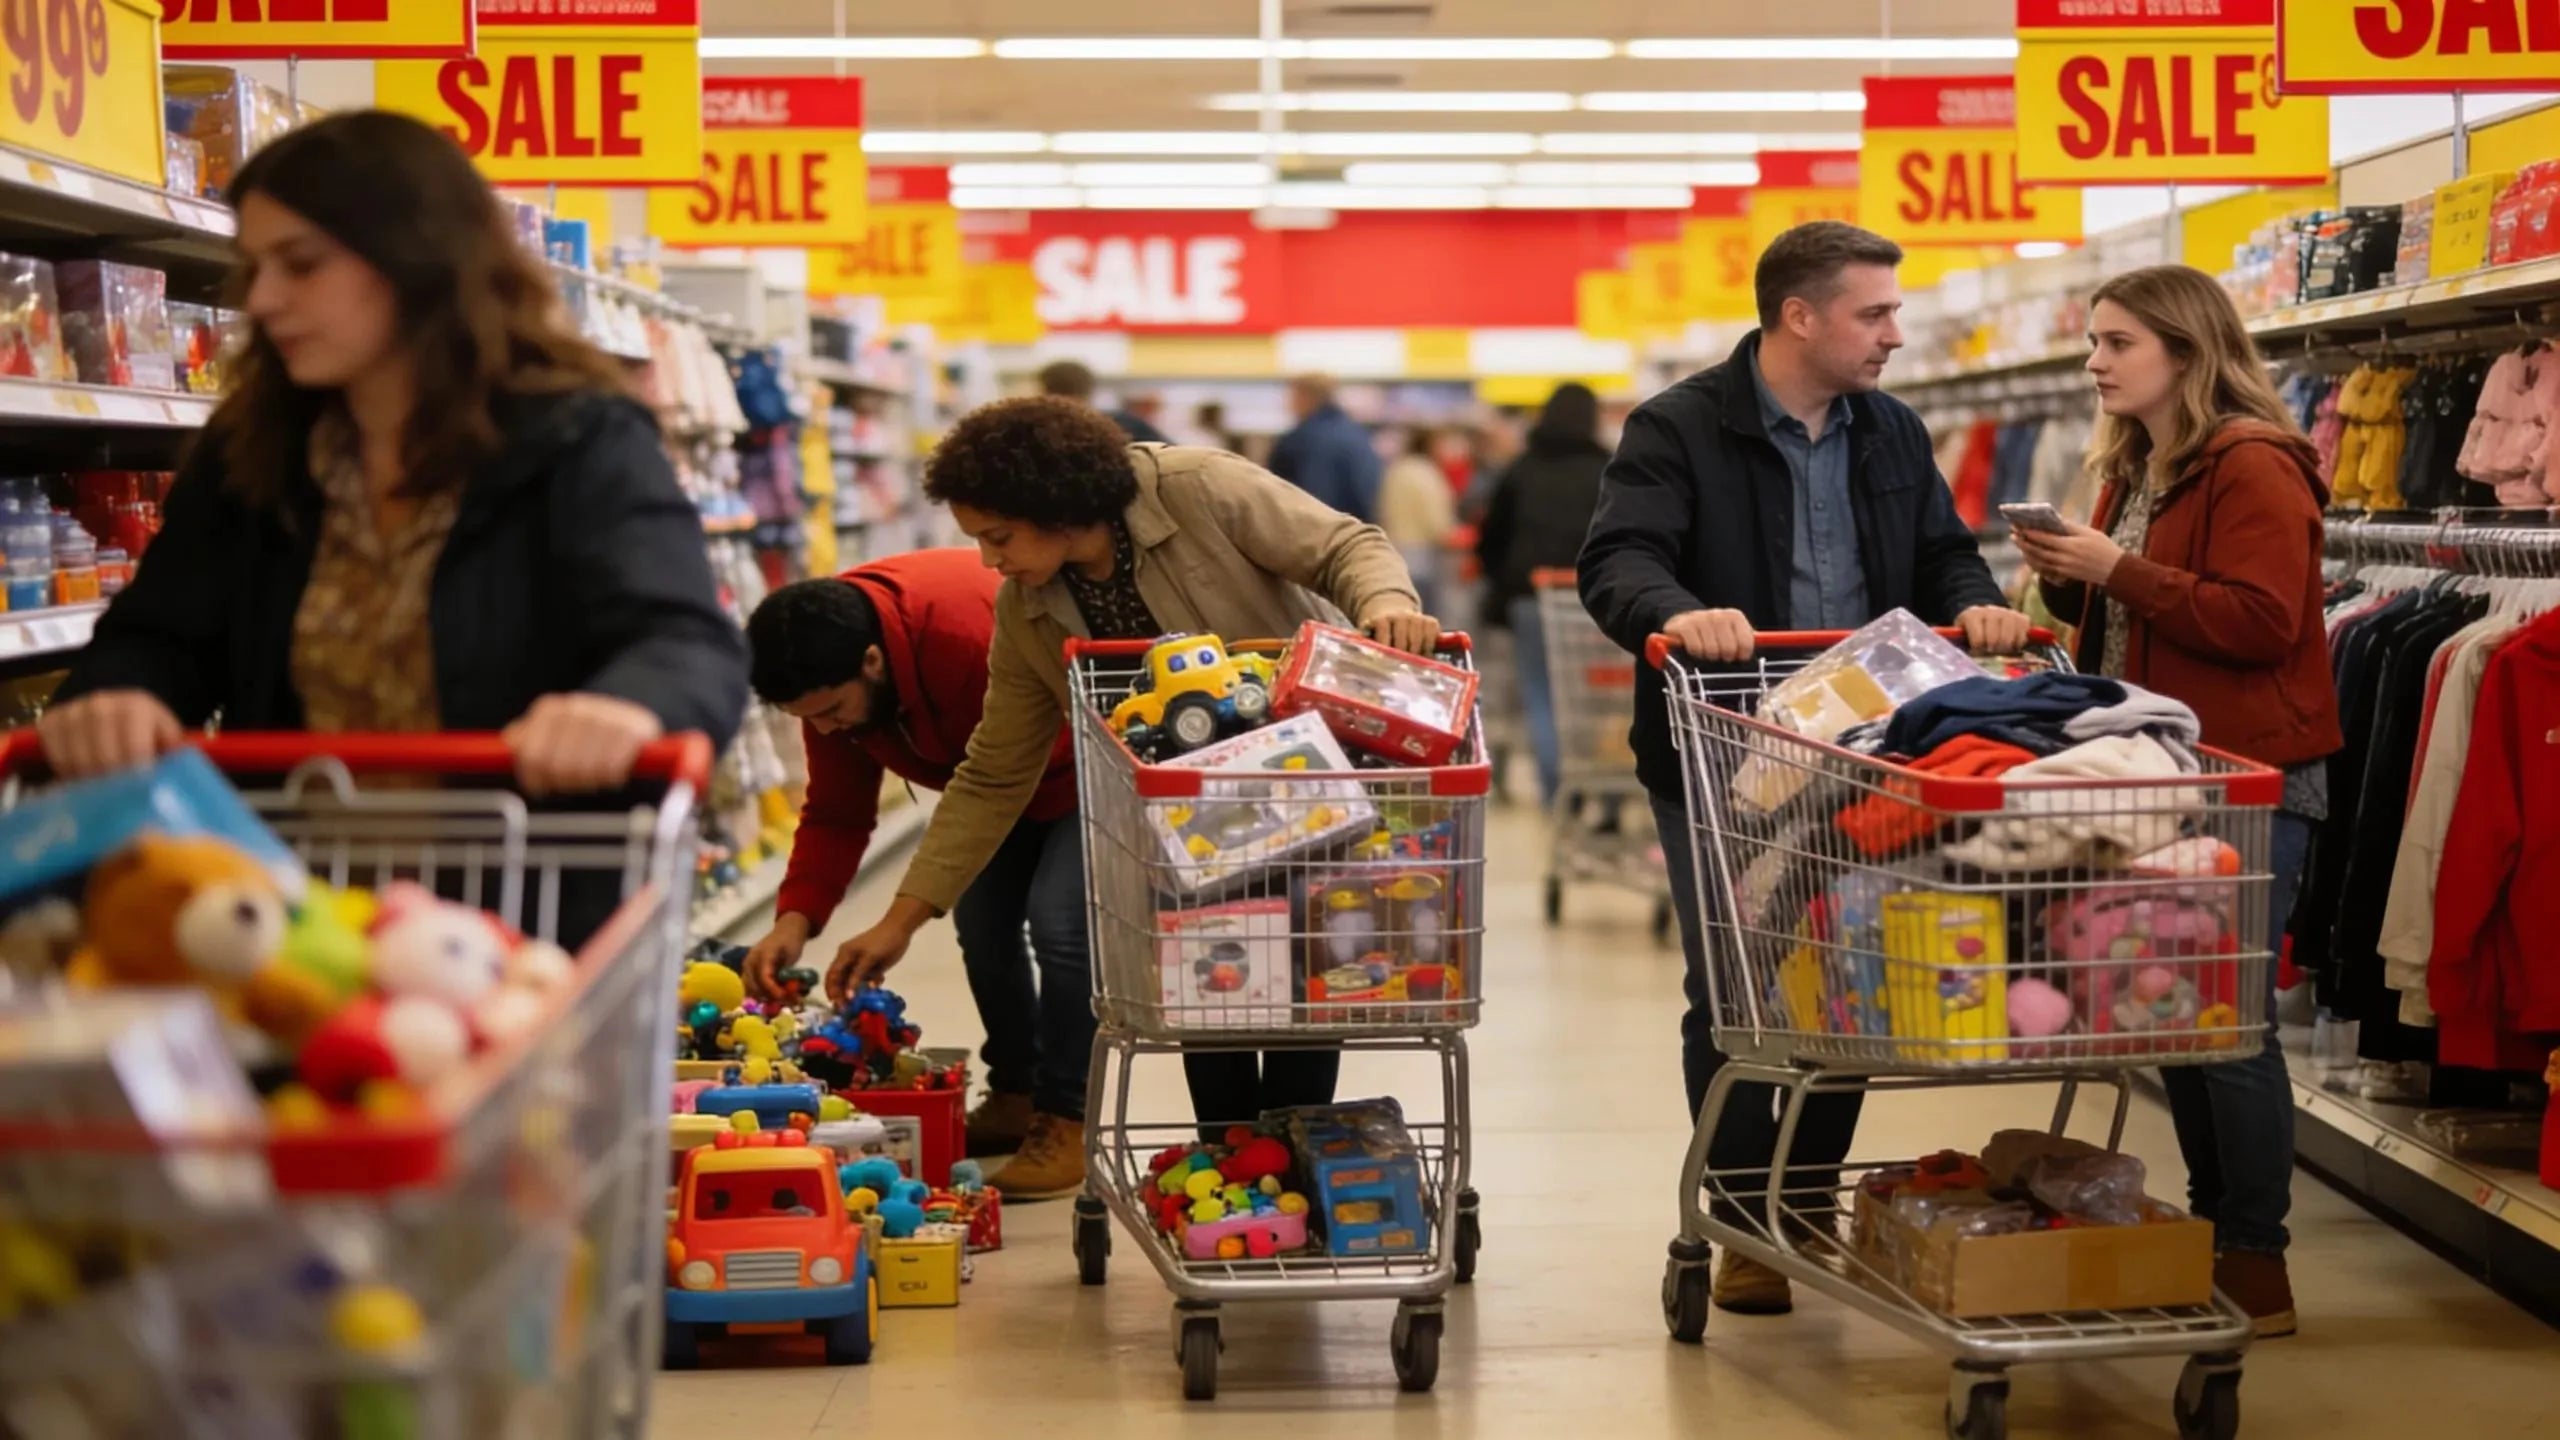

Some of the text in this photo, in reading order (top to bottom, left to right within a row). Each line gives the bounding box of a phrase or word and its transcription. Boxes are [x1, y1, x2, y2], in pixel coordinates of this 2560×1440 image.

[436, 54, 643, 159] SALE
[2057, 55, 2256, 160] SALE
[688, 152, 829, 225] SALE
[1033, 235, 1245, 325] SALE
